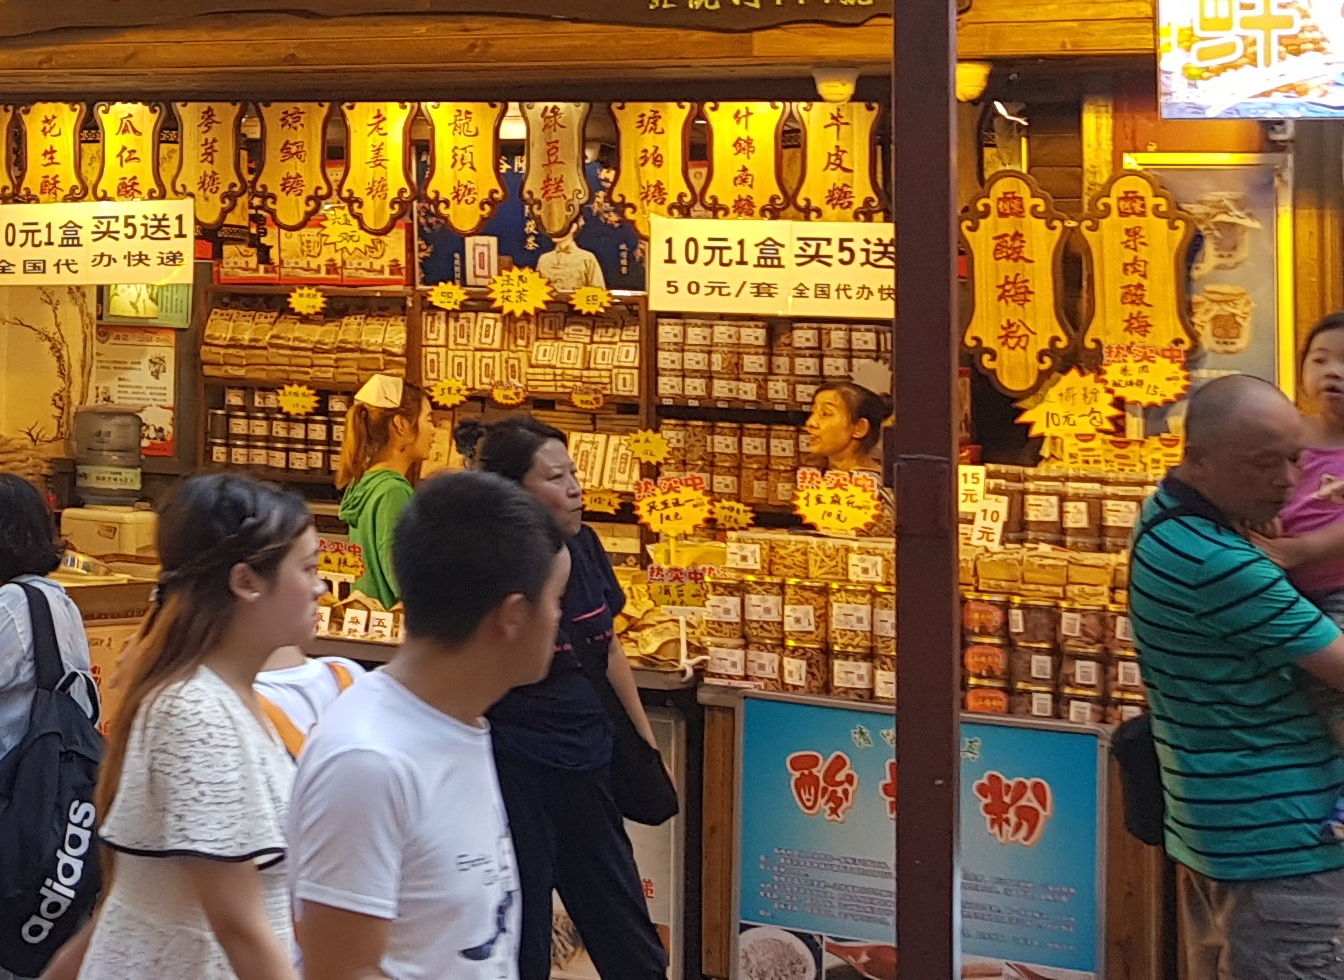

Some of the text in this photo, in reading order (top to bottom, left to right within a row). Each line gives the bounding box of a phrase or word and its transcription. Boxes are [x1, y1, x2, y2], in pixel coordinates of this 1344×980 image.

[39, 113, 66, 203] 花生酥
[364, 108, 391, 202] 老姜糖
[823, 107, 857, 211] 牛皮糖
[665, 279, 779, 298] 50元/套
[991, 230, 1038, 351] 酸梅粉
[1118, 225, 1155, 346] 果肉酸梅
[961, 472, 981, 485] 15
[961, 488, 979, 503] 元
[980, 508, 1000, 522] 10
[976, 526, 997, 542] 元
[19, 798, 98, 946] adidas
